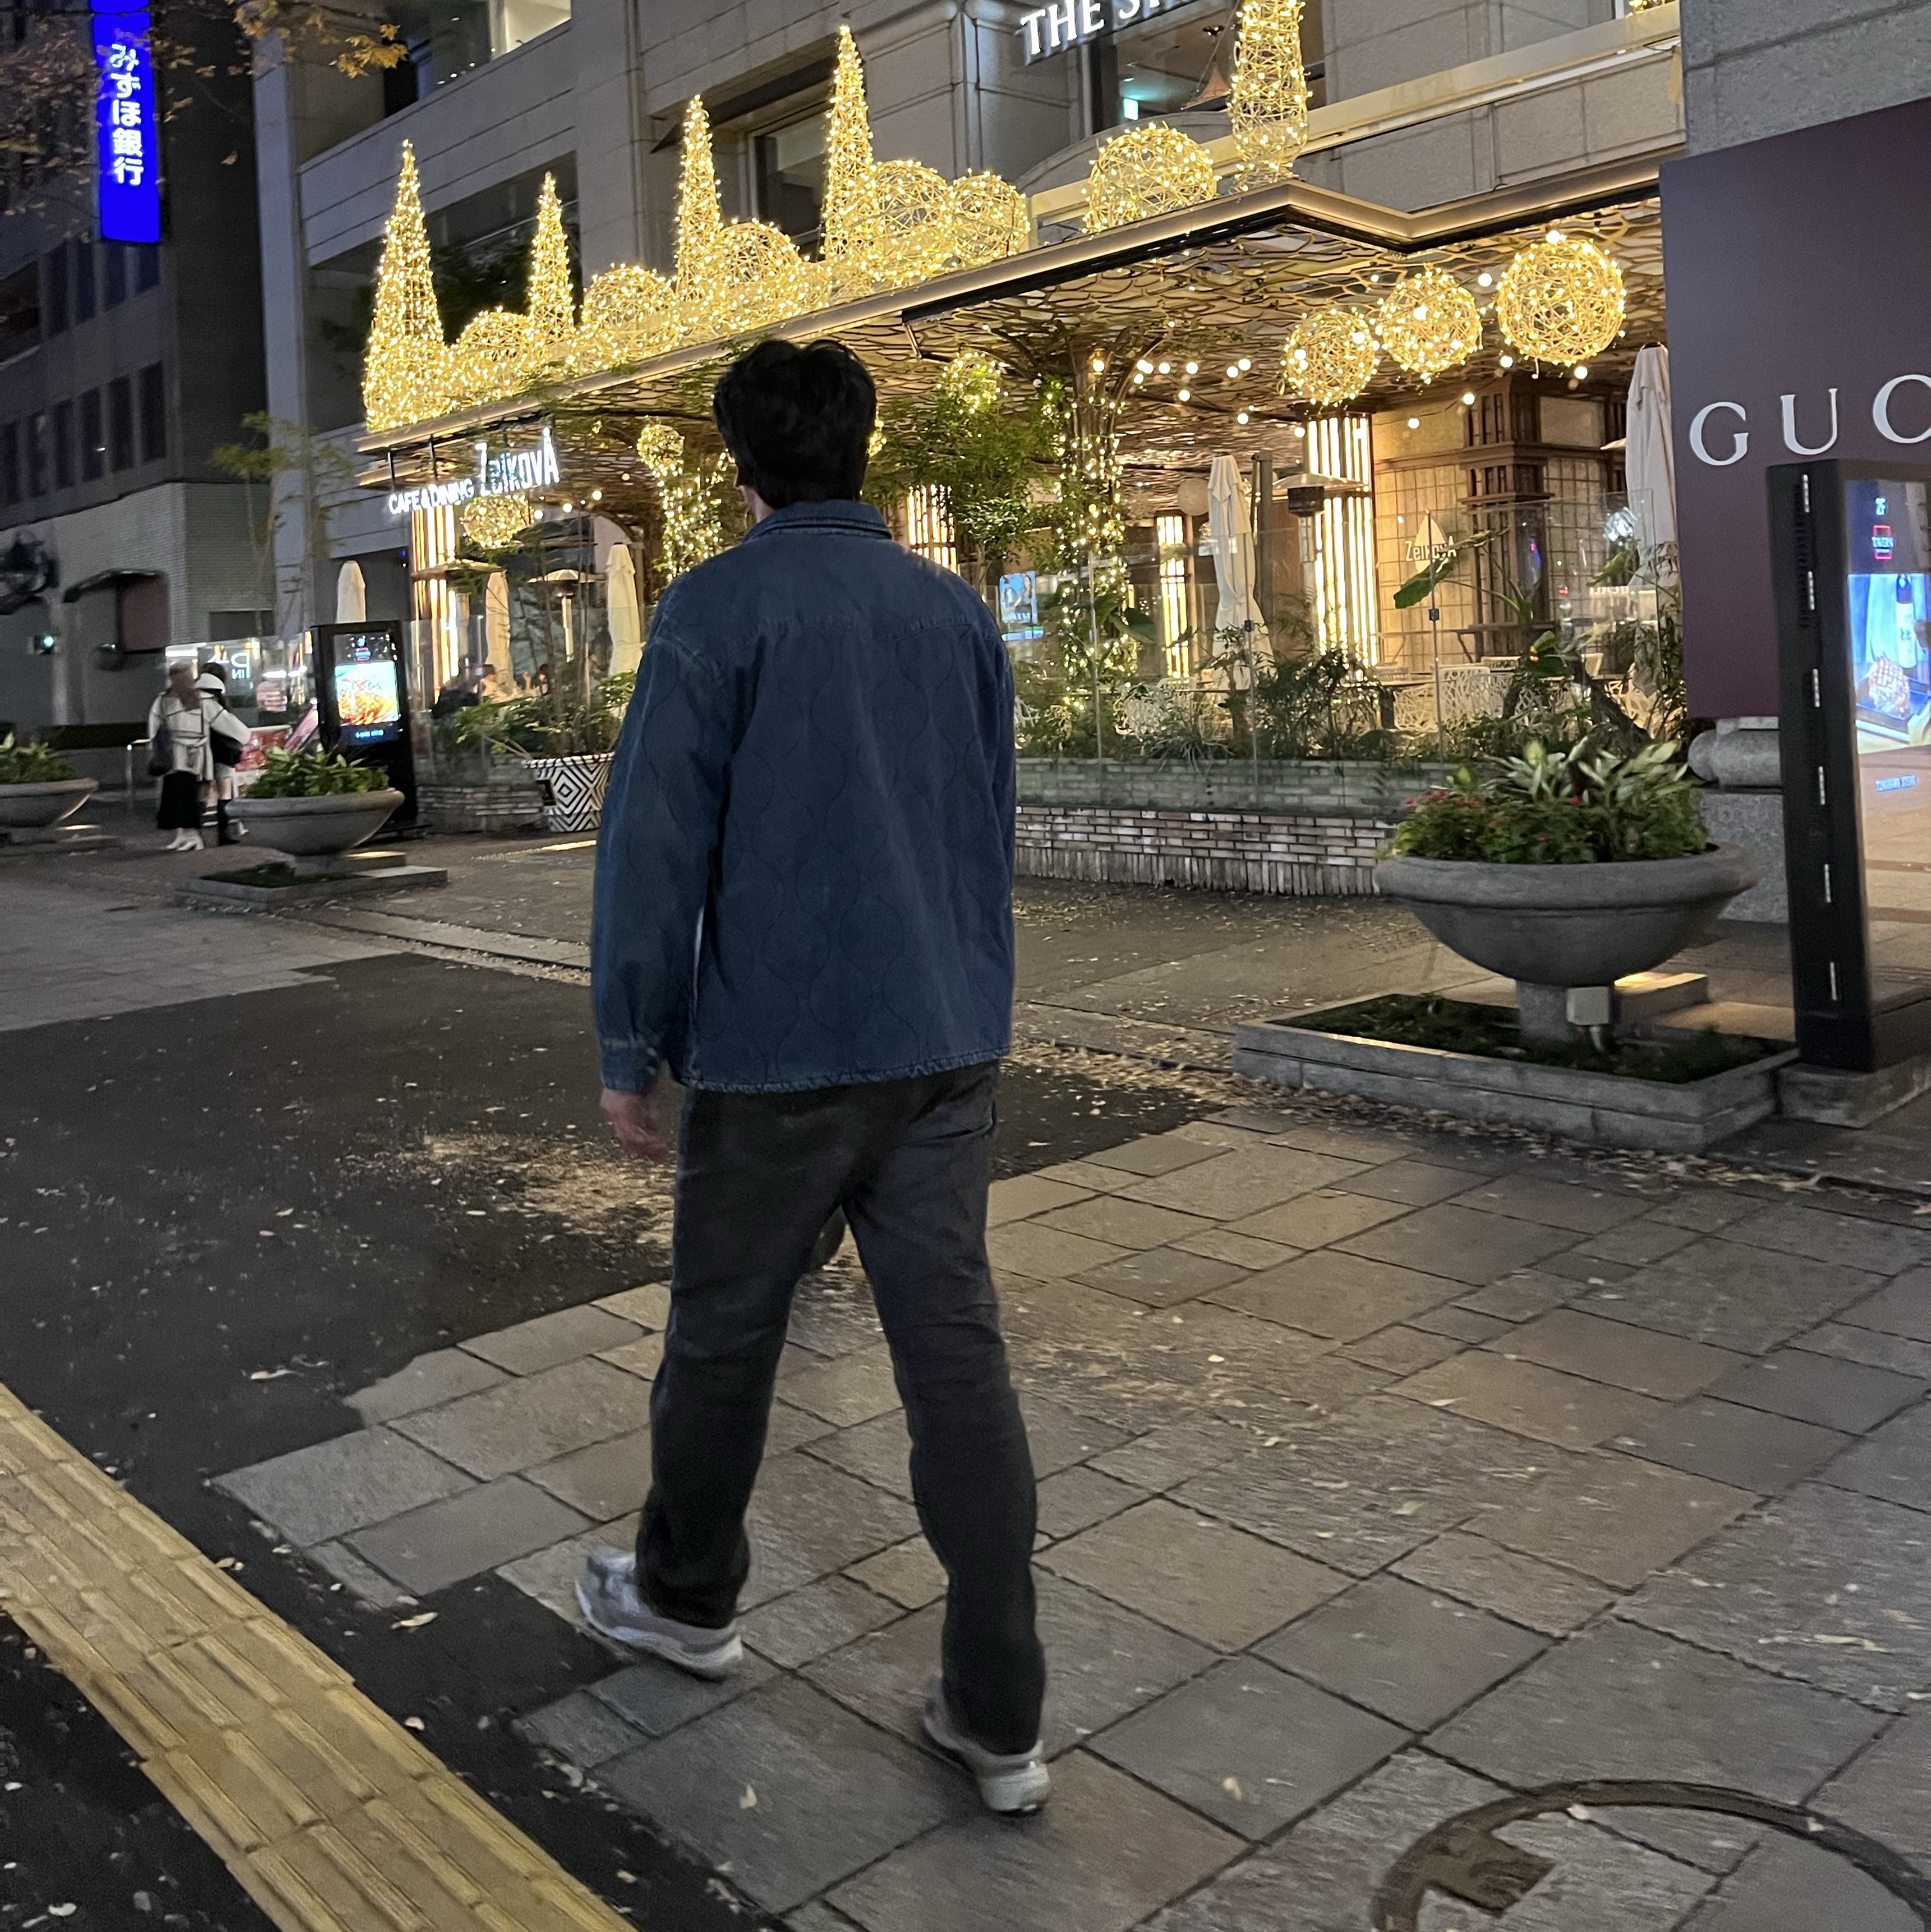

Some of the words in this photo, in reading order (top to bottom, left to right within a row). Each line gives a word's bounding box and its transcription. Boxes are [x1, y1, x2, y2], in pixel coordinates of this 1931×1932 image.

[1020, 0, 1104, 55] THE
[109, 43, 144, 186] みずほ銀行
[1690, 374, 1931, 466] GUC
